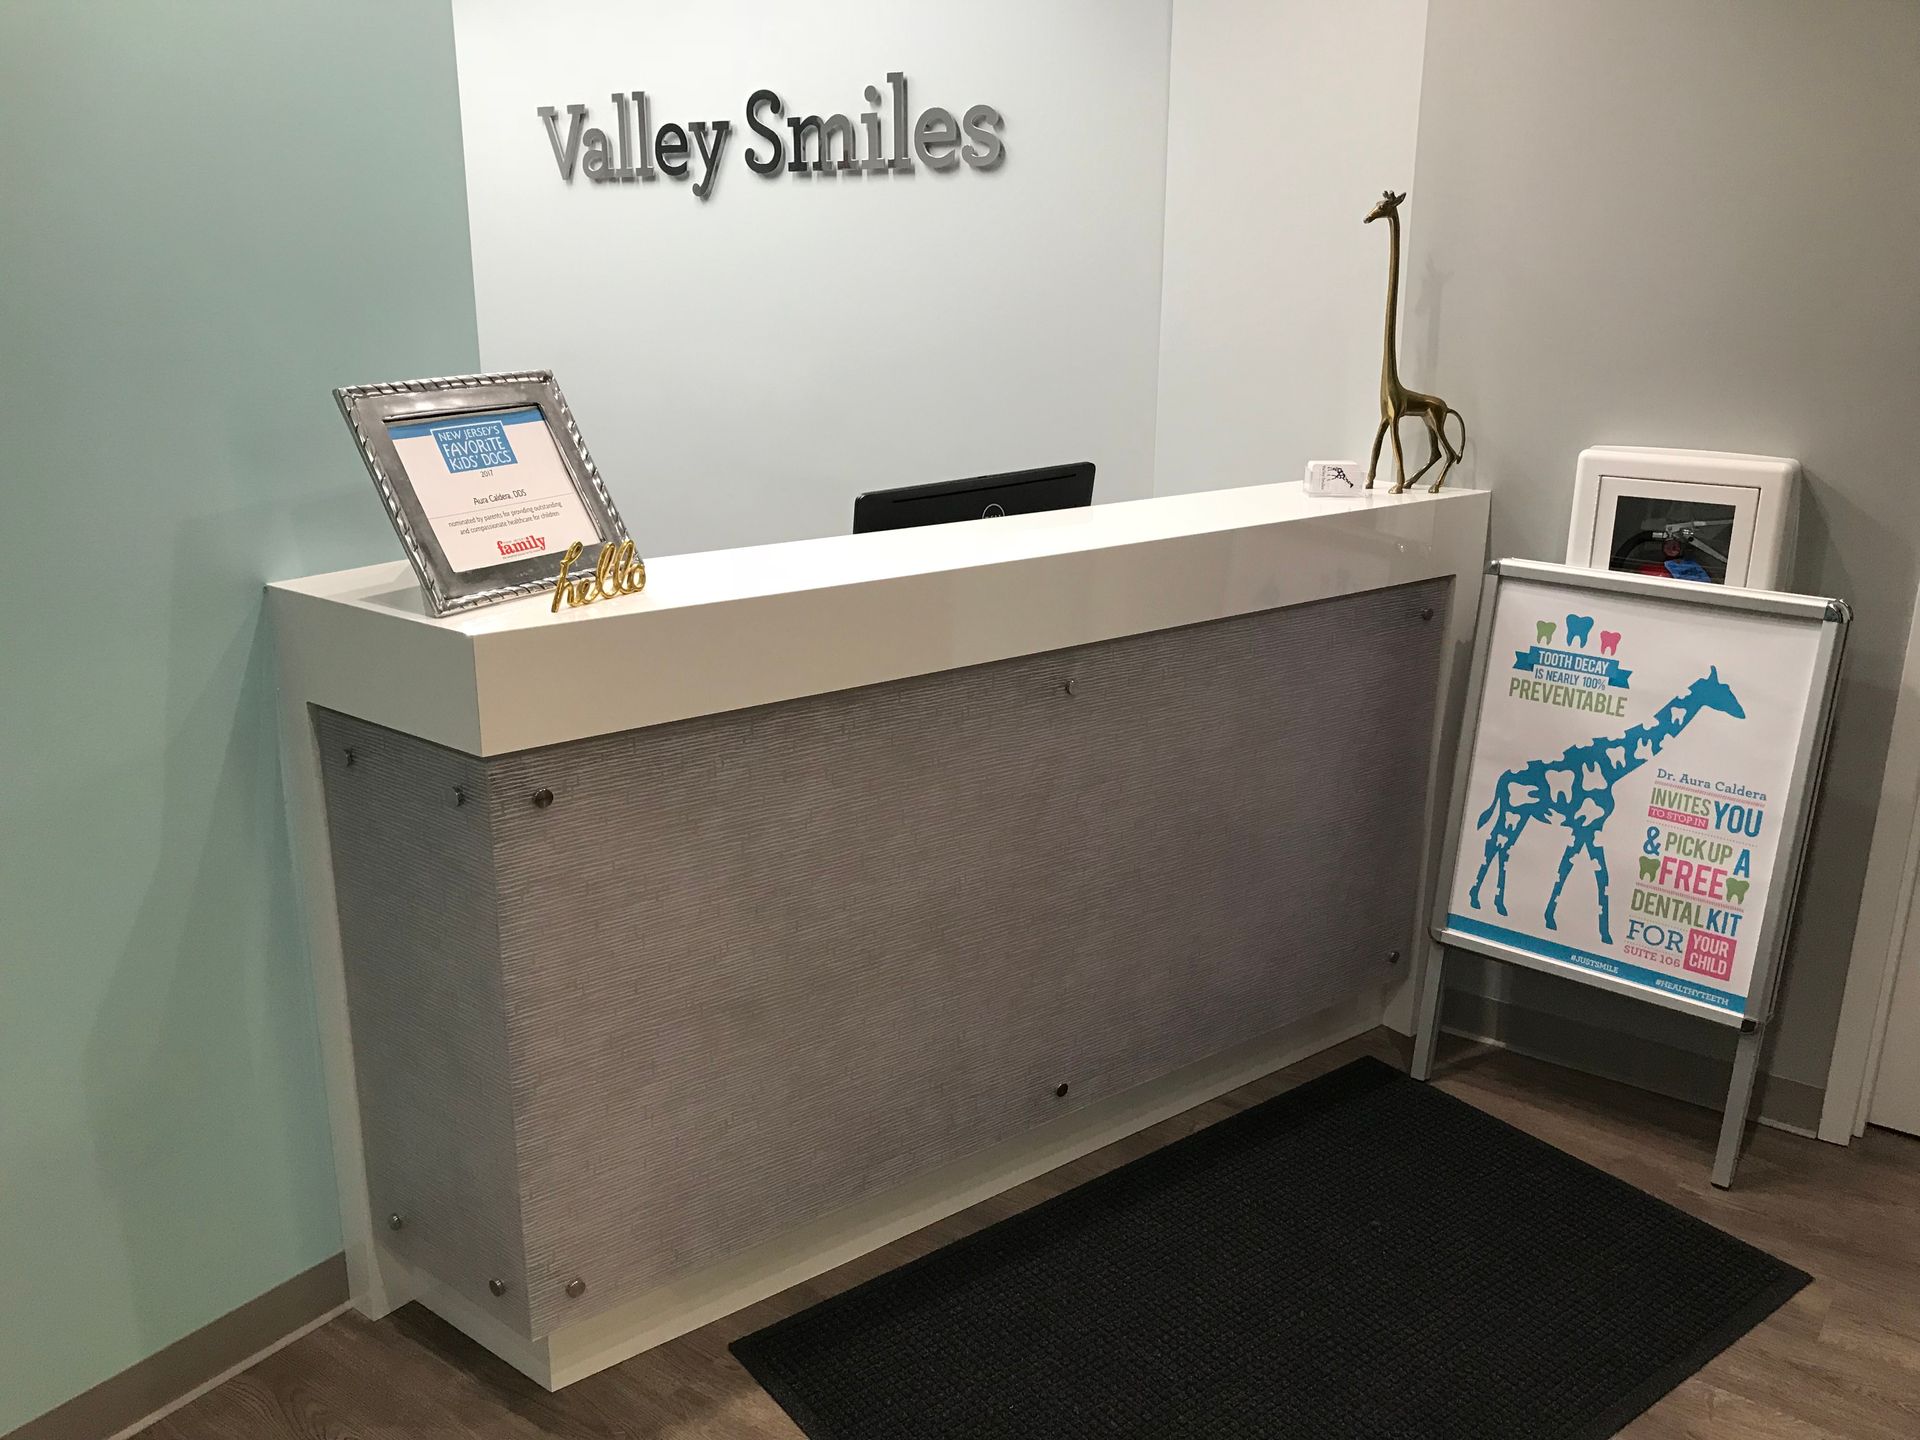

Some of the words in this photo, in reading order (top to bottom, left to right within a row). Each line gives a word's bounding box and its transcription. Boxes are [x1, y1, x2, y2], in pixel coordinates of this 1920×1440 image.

[537, 91, 731, 197] Valley
[745, 72, 1002, 174] Smiles
[438, 430, 461, 442] NEW
[463, 425, 500, 440] JERSEY'S
[481, 450, 512, 466] DOCS
[480, 470, 494, 478] 2017
[473, 497, 489, 506] Aura
[513, 488, 527, 499] DDS
[448, 516, 476, 528] nominated
[475, 516, 485, 524] by
[484, 512, 502, 523] parents
[502, 510, 511, 518] for
[510, 506, 535, 517] providing
[534, 501, 563, 512] outstanding
[460, 526, 471, 535] and
[470, 521, 508, 534] compassionate
[508, 516, 534, 527] healthcare
[533, 513, 541, 521] for
[540, 510, 560, 520] children
[496, 534, 547, 556] family
[551, 540, 647, 613] hello
[1539, 650, 1573, 669] TOOTH
[1574, 657, 1610, 675] DECAY
[1534, 667, 1544, 680] IS
[1545, 669, 1580, 686] NEARLY
[1582, 676, 1606, 691] 100%
[1508, 677, 1628, 718] PREVENTABLE
[1657, 768, 1676, 782] Dr.
[1679, 773, 1711, 789] Aura
[1715, 780, 1767, 801] Caldera
[1650, 787, 1712, 817] INVITES
[1714, 800, 1764, 838] YOU
[1651, 807, 1665, 818] TO
[1666, 811, 1694, 824] STOP
[1693, 816, 1707, 828] IN
[1643, 825, 1661, 857] &
[1664, 831, 1708, 861] PICK
[1707, 840, 1733, 866] UP
[1733, 848, 1751, 878] A
[1659, 855, 1728, 900] FREE
[1630, 888, 1704, 929] DENTAL
[1705, 907, 1743, 937] KIT
[1626, 918, 1684, 954] FOR
[1693, 933, 1730, 959] YOUR
[1570, 953, 1619, 975] #JUSTSMILE
[1623, 944, 1657, 963] SUITE
[1659, 954, 1681, 968] 106
[1688, 951, 1727, 976] CHILD
[1655, 978, 1730, 1006] #HEALTHYTEETH
